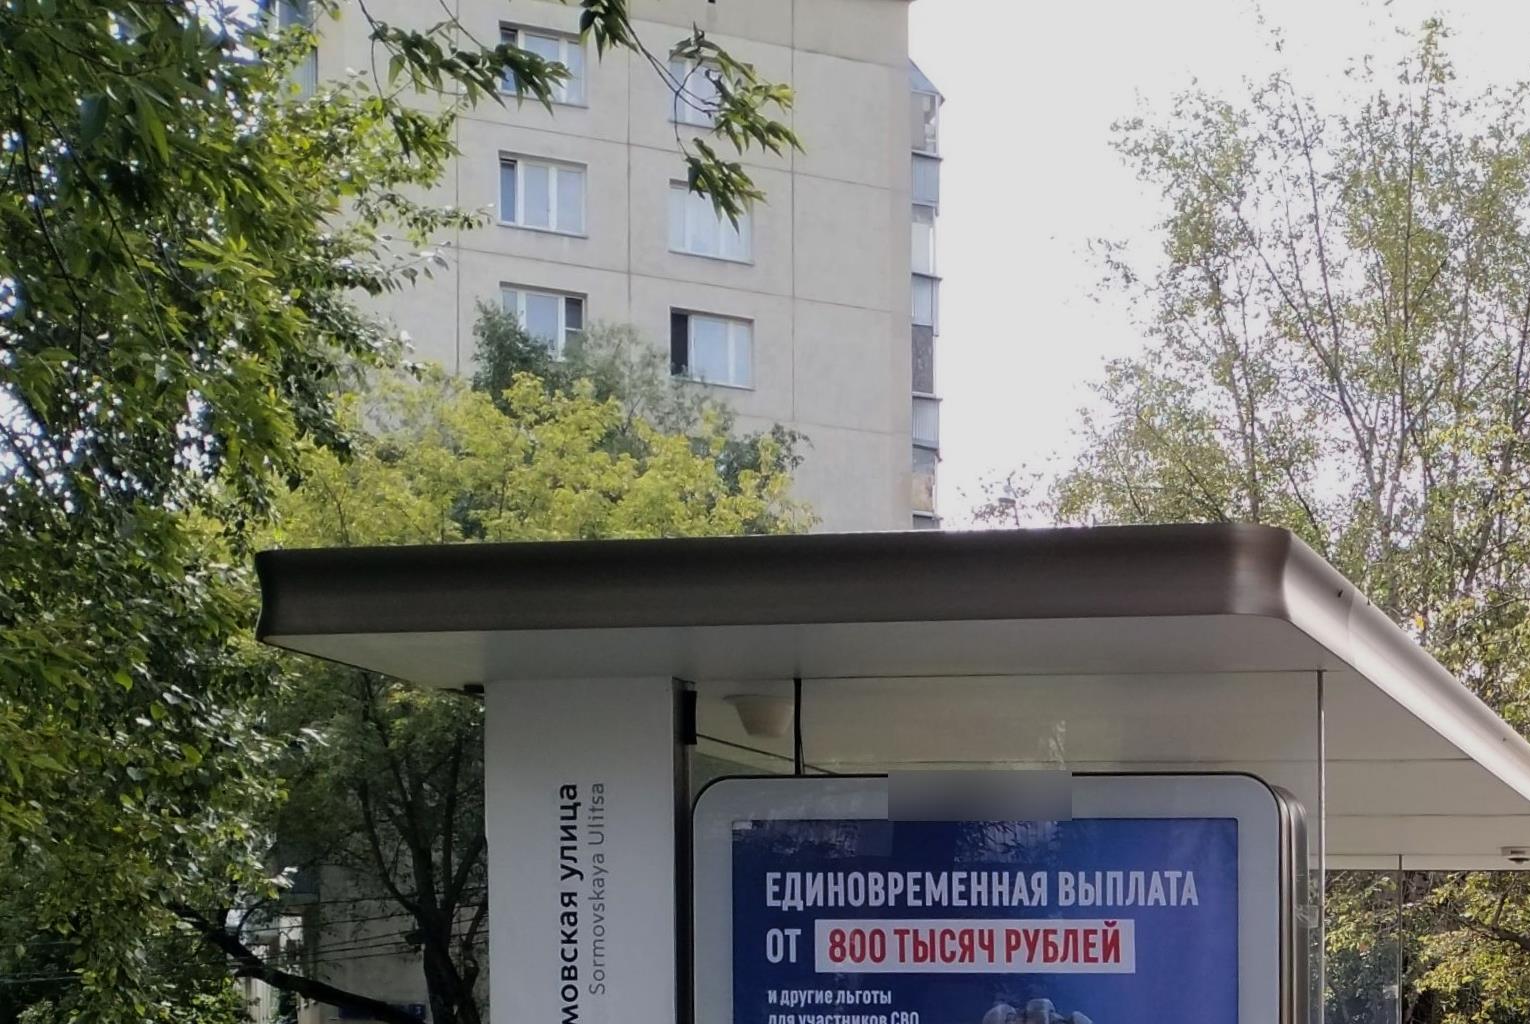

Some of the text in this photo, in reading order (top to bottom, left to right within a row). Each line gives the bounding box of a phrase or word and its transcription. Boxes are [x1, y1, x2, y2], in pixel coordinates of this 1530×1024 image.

[558, 783, 584, 881] улица
[588, 783, 609, 995] Sormovskaya Ulitsa
[765, 870, 1199, 912] ЕДИНОВРЕМЕННАЯ ВЫПЛАТА
[766, 919, 1120, 964] ОТ 800 ТЫСЯЧ РУБЛЕЙ
[768, 989, 892, 1008] и другие льготы
